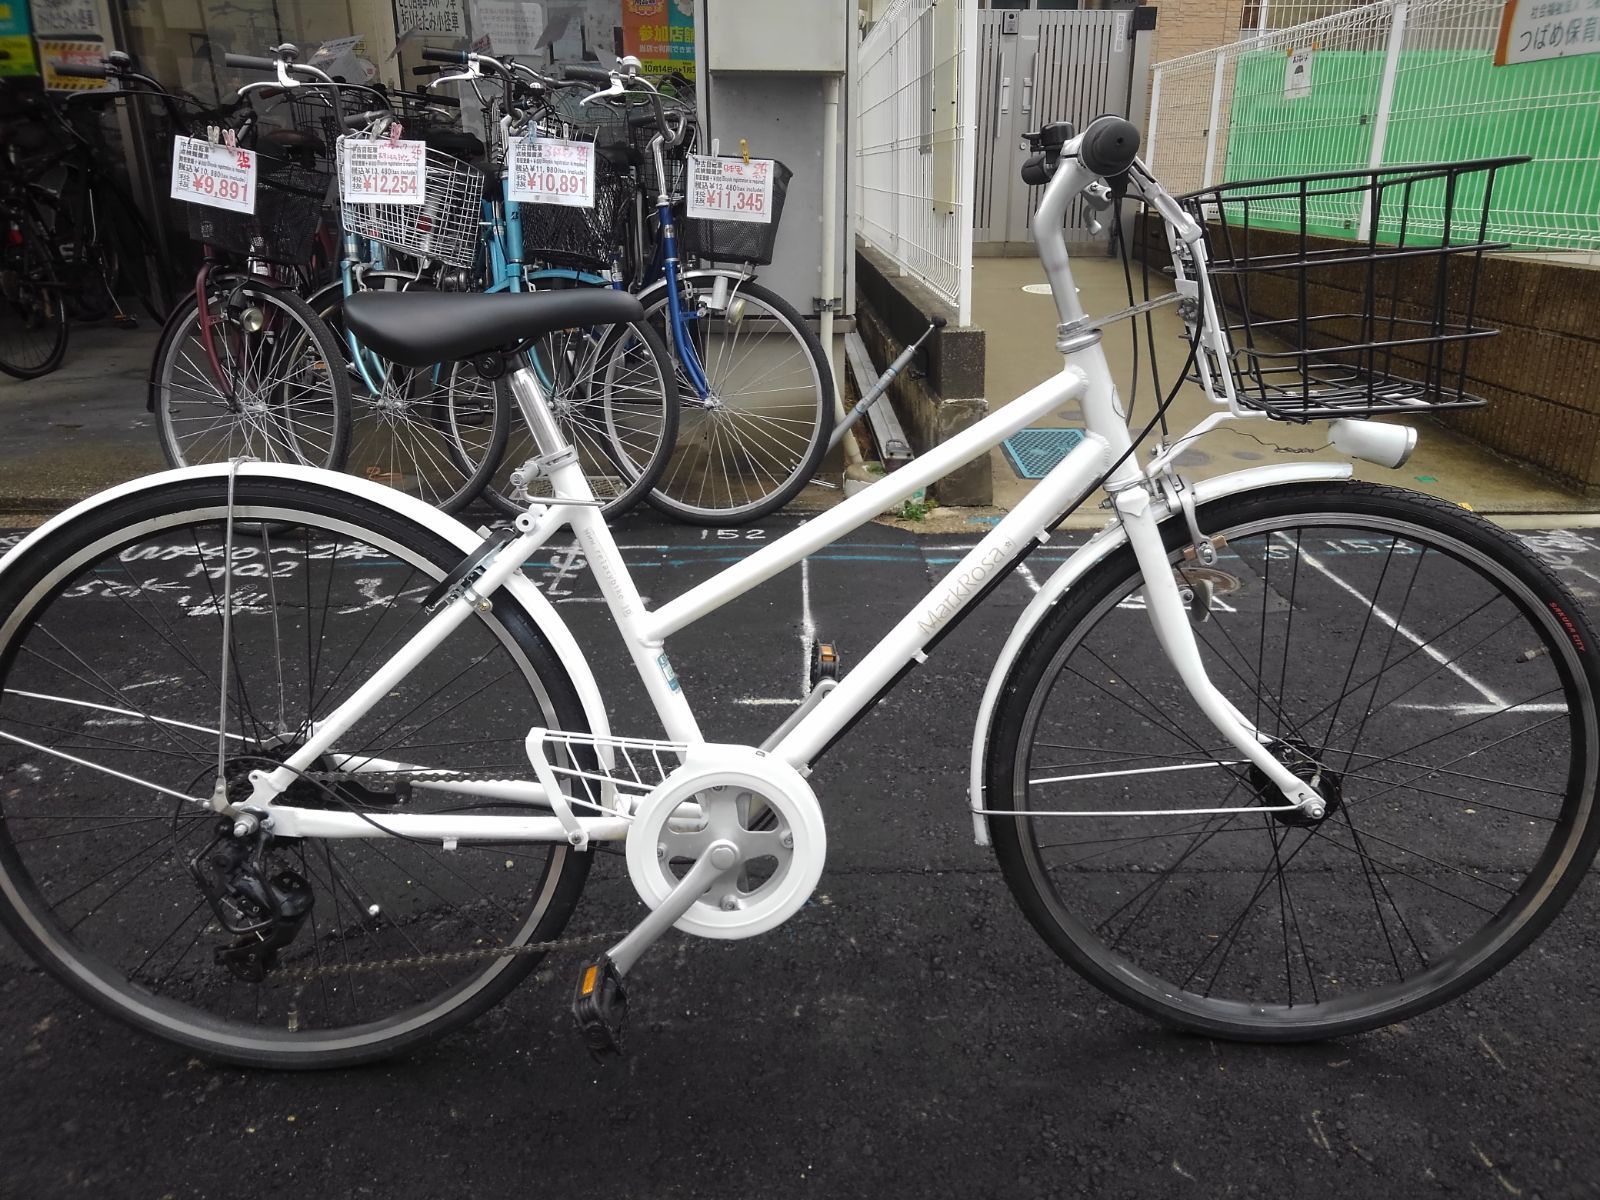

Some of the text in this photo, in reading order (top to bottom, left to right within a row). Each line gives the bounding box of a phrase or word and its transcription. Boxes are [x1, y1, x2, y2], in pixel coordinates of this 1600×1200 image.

[1519, 17, 1600, 52] つばめ保育
[193, 173, 248, 201] ¥9,891
[363, 175, 417, 195] ¥12,254
[527, 172, 586, 195] ¥10,891
[707, 190, 764, 212] ¥11,345
[701, 529, 766, 539] 152
[917, 547, 1005, 635] MarkRosa
[1549, 601, 1586, 653] SAKURA CITY
